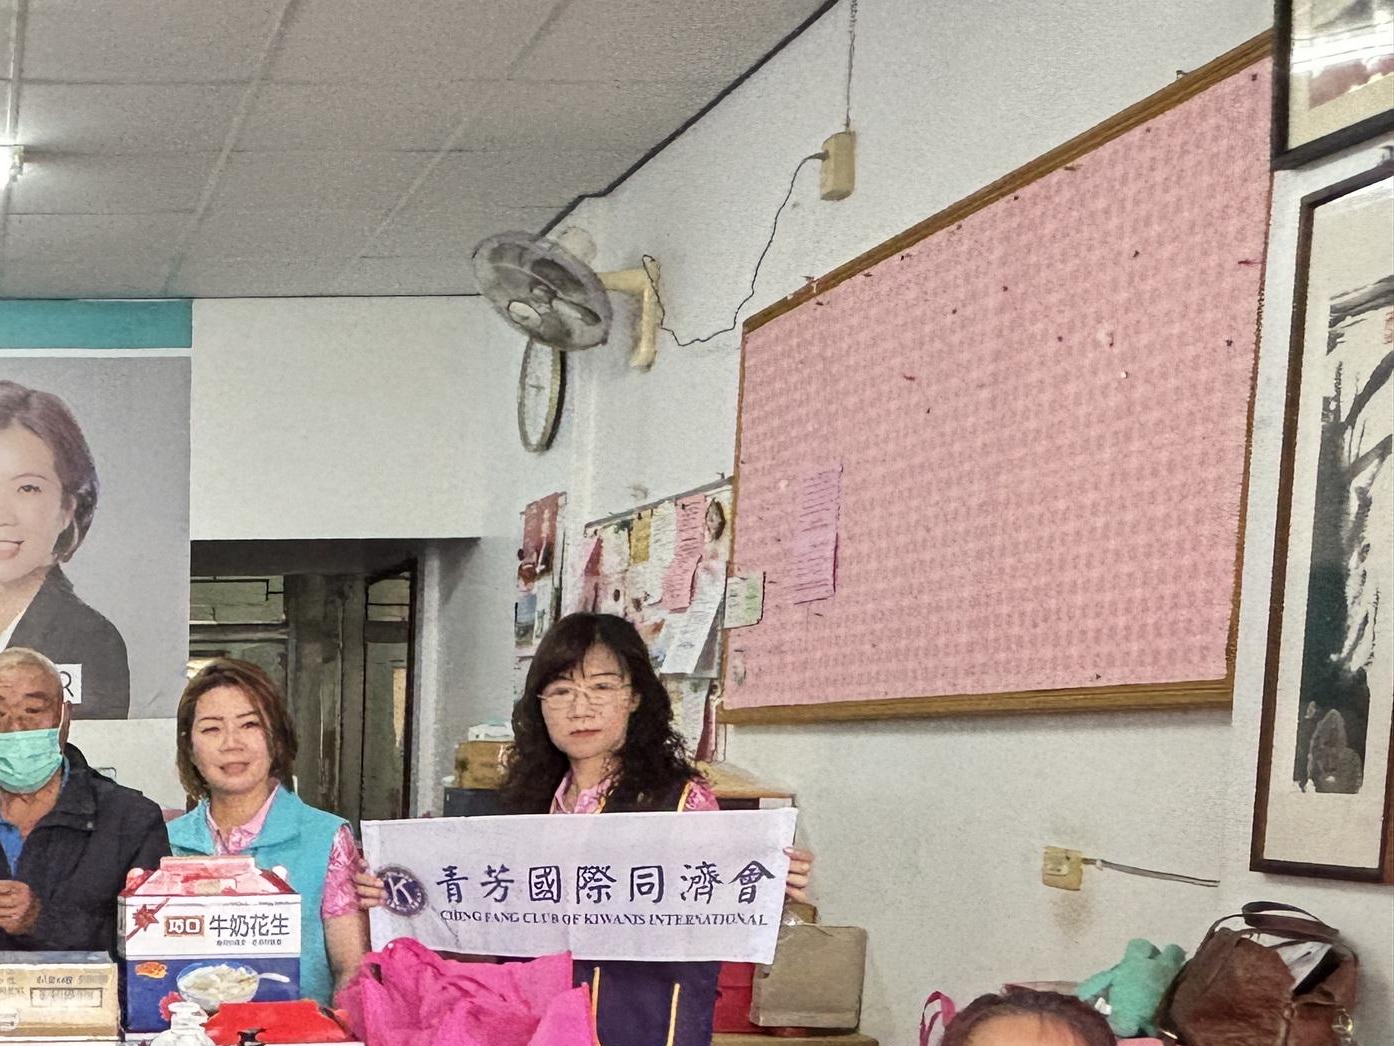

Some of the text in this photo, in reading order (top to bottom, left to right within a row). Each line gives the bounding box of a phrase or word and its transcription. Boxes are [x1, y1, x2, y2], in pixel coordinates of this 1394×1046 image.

[436, 860, 776, 905] 青芳國際同濟會
[209, 912, 290, 937] 牛奶花生
[440, 910, 768, 926] CHING FANG CLUB OF KIWANIS INTERNATIONAL
